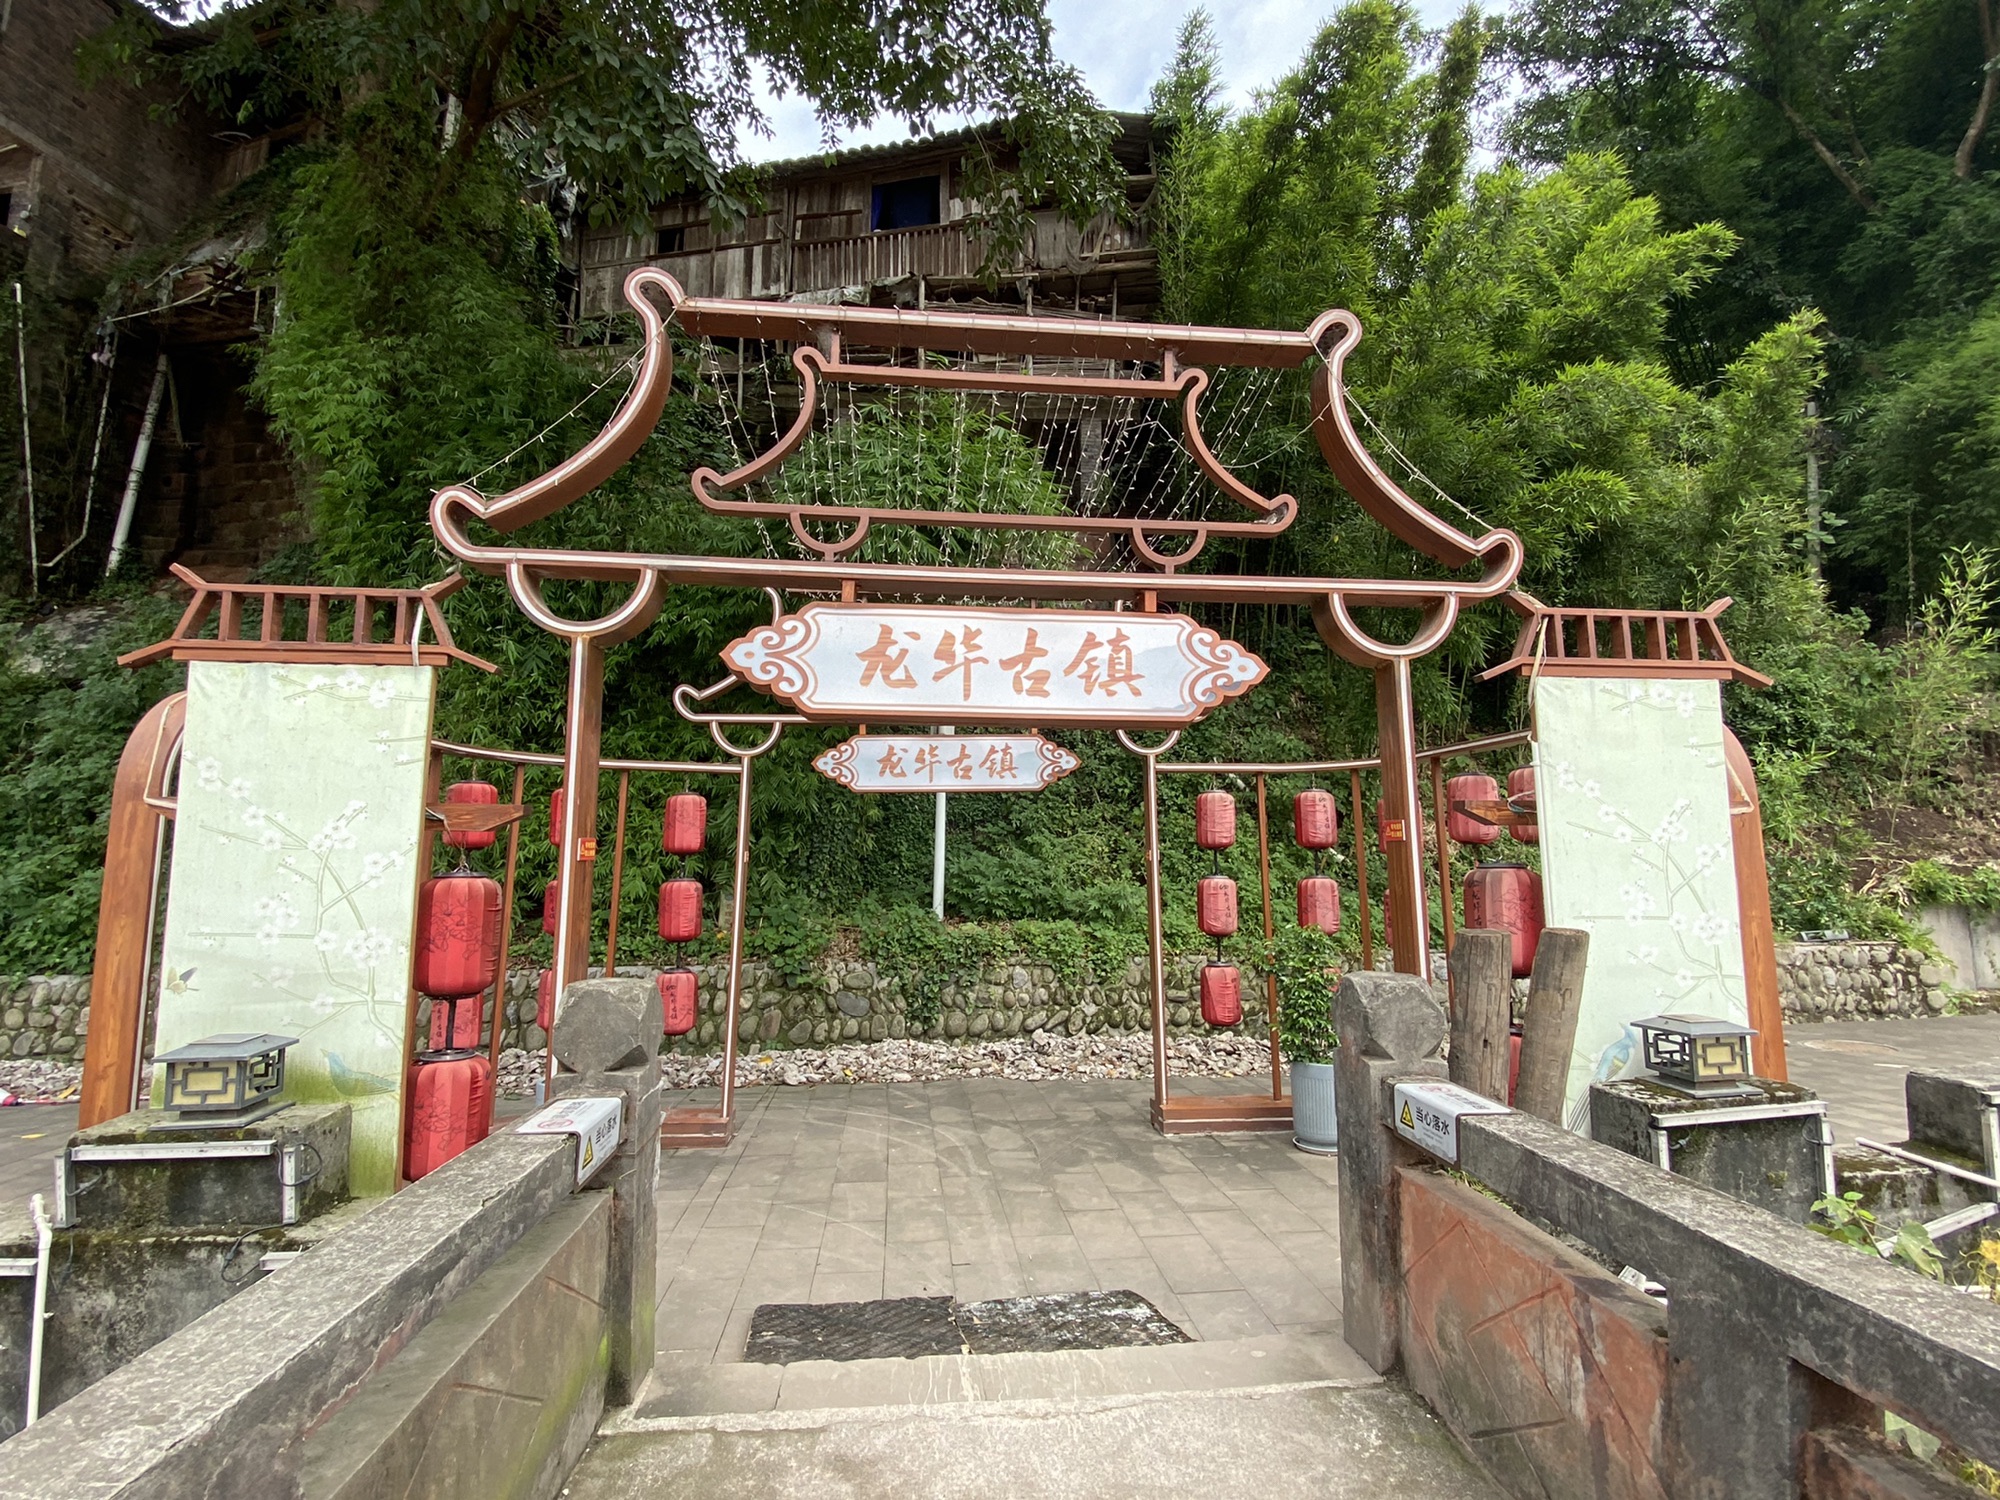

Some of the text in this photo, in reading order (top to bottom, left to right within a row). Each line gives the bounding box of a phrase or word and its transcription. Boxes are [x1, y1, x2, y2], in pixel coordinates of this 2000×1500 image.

[855, 624, 1146, 702] 龙华古镇
[876, 742, 1019, 784] 龙华古镇
[1415, 1105, 1450, 1136] 当心落水
